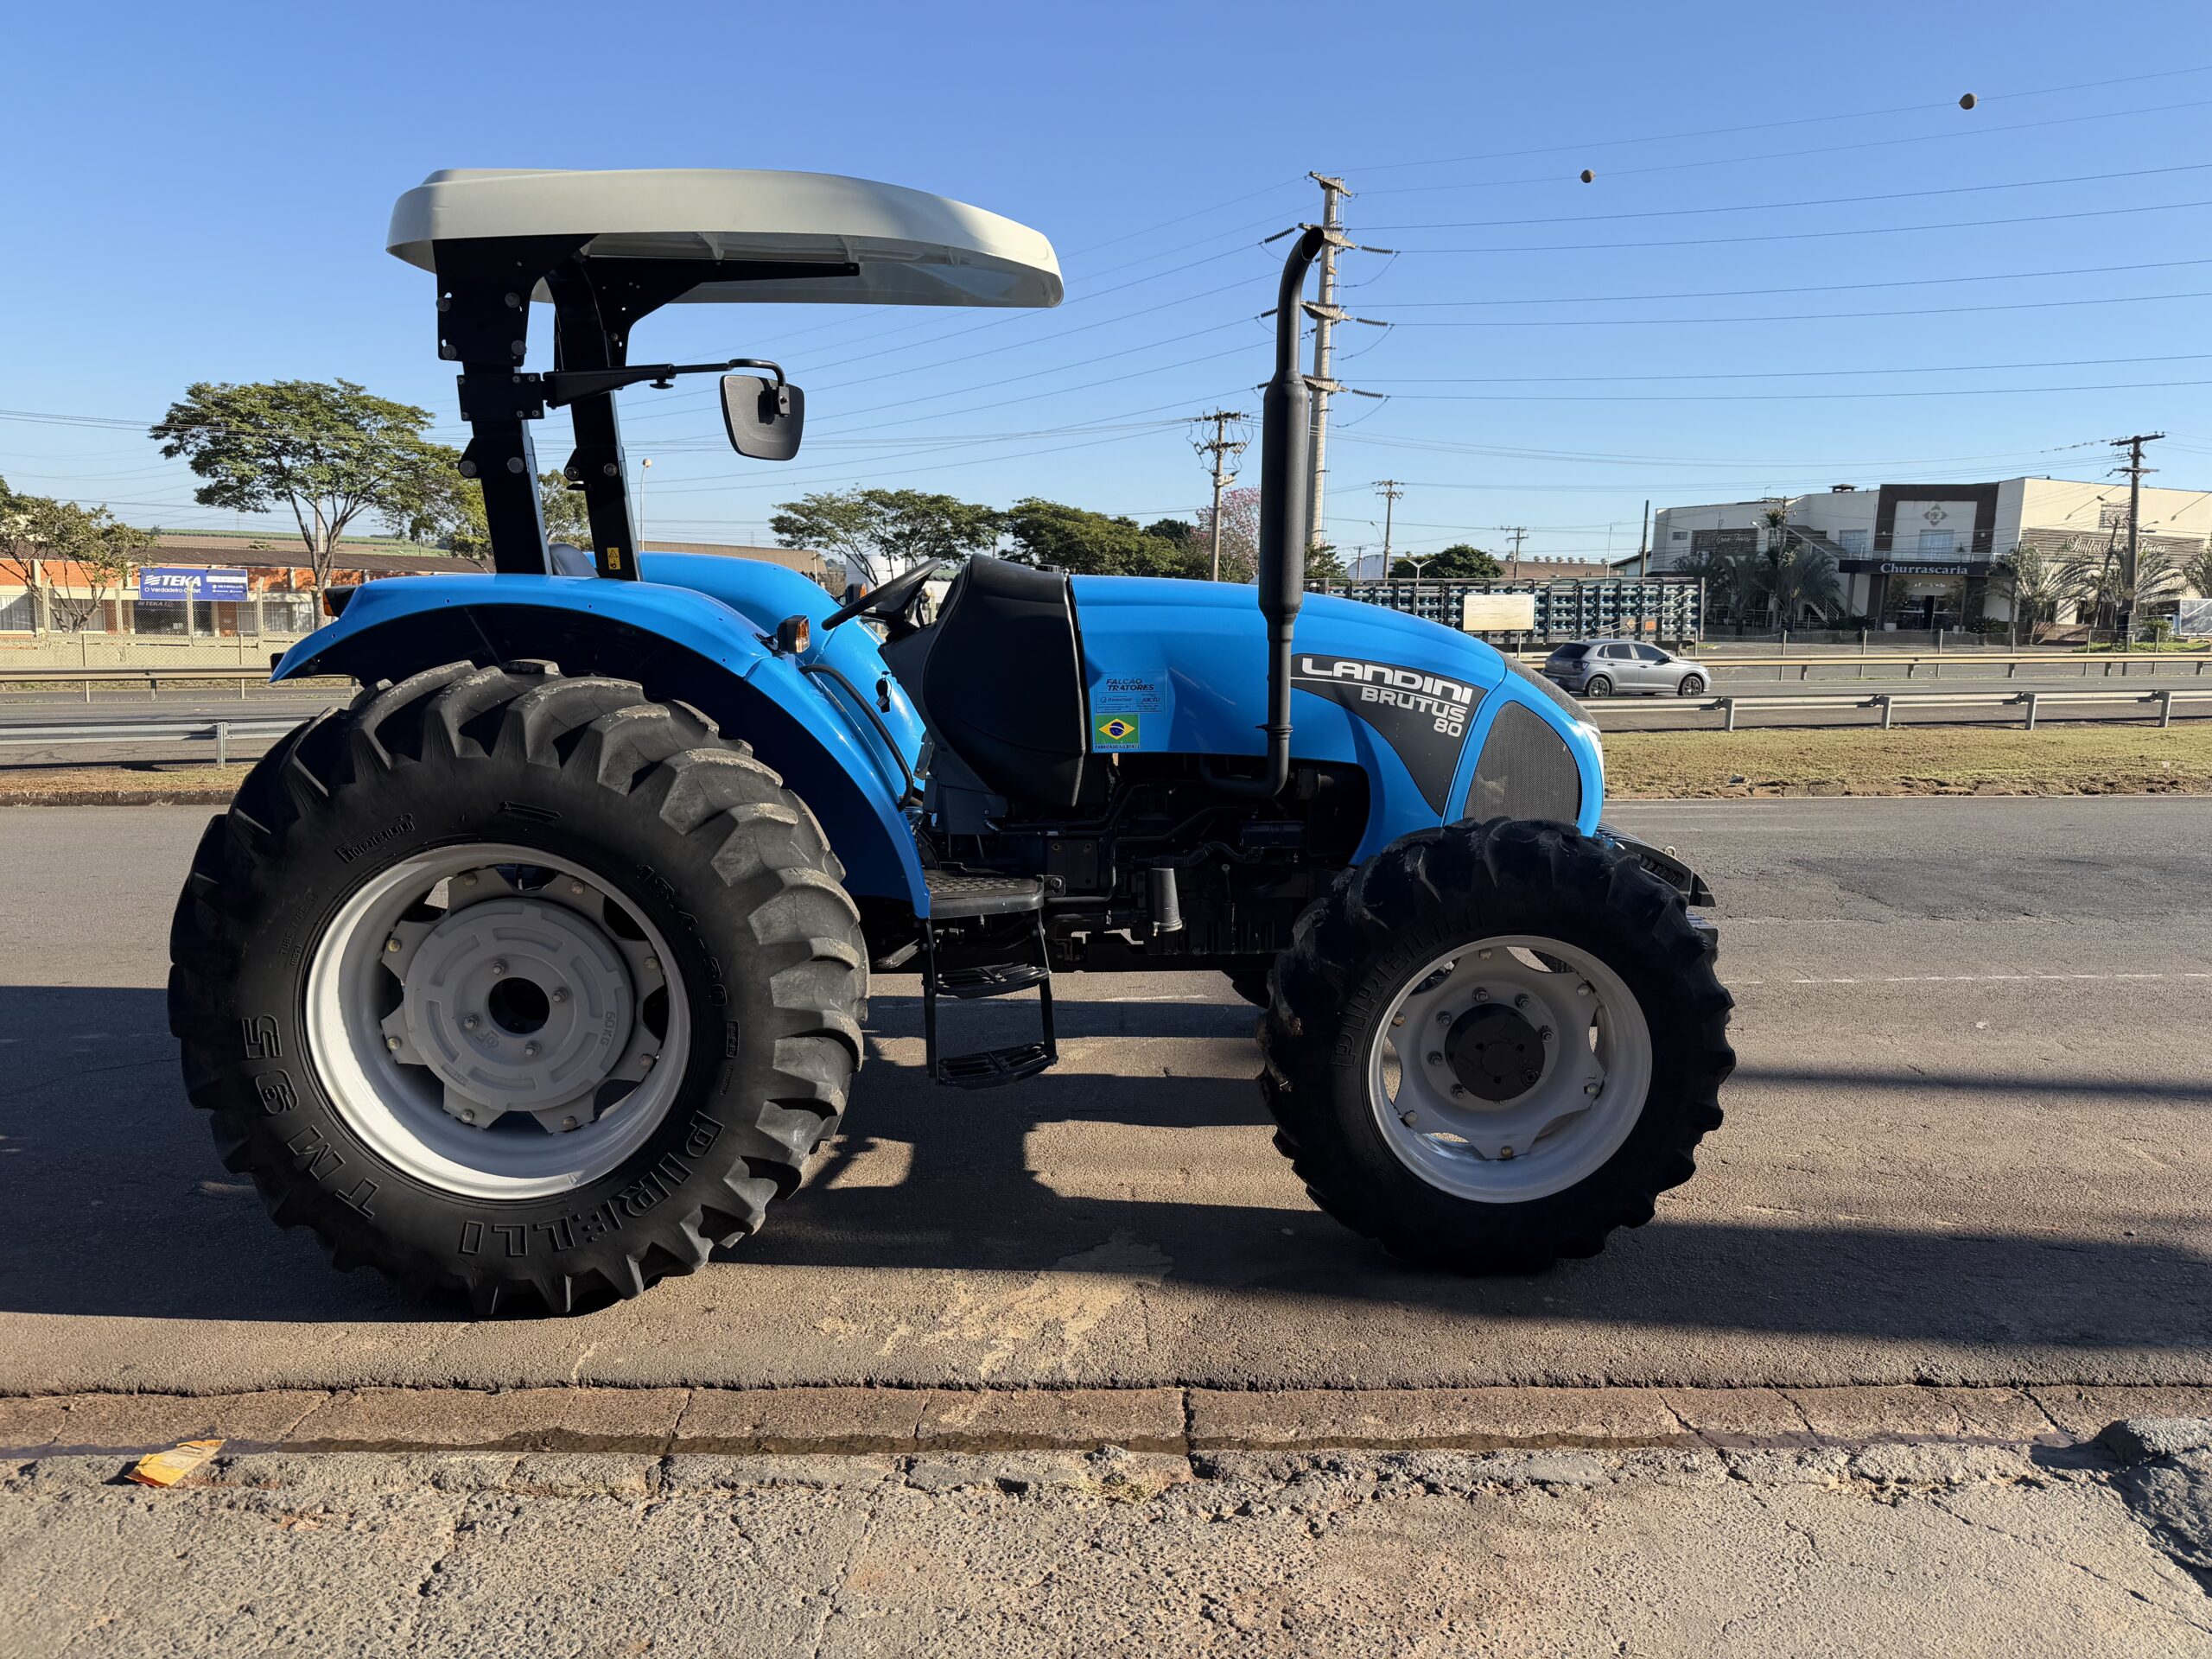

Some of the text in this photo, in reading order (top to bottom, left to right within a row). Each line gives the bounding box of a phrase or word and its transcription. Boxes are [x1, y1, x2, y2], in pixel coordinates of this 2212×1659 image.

[2064, 535, 2103, 556] Buffet
[162, 575, 201, 587] TEKA
[1880, 563, 1968, 575] Churrascaria
[1301, 658, 1473, 705] LANDINI
[1360, 686, 1467, 723] BRUTUS
[1433, 718, 1463, 738] 80
[1329, 905, 1486, 1068] PIRELLI
[458, 1109, 726, 1257] PIRELLI
